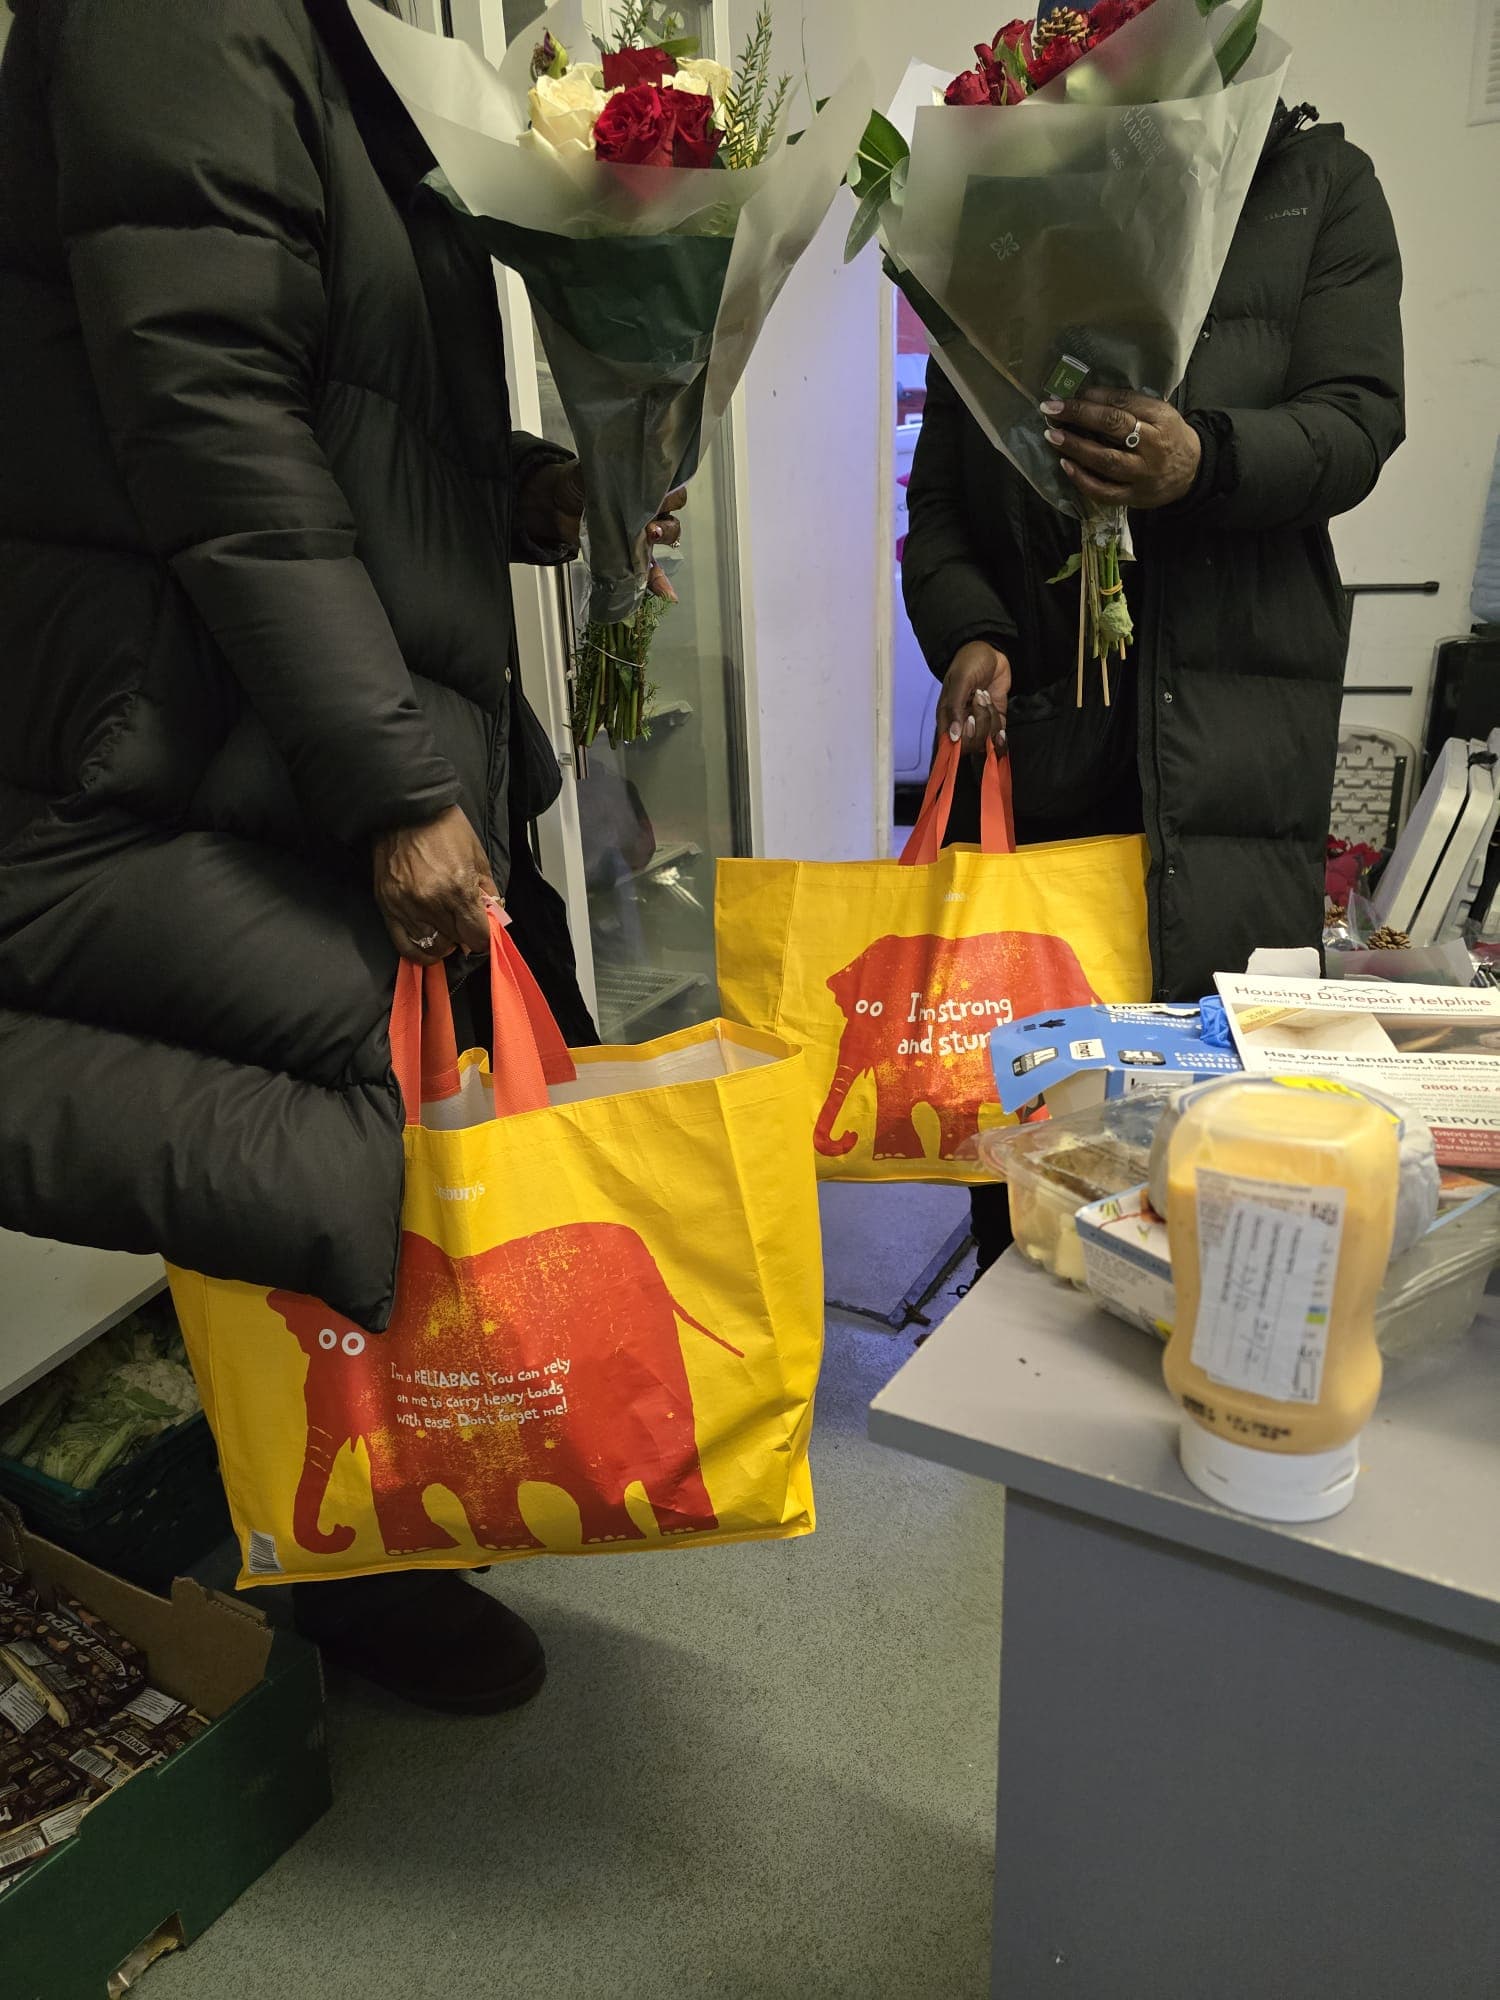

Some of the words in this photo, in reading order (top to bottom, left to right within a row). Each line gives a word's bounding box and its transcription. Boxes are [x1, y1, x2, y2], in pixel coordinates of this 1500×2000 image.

[1111, 1003, 1163, 1011] kmart
[1234, 986, 1312, 1001] Housing
[1318, 990, 1404, 1006] Disrepair
[1410, 996, 1492, 1010] Helpline
[938, 998, 1014, 1024] strong
[897, 1024, 933, 1055] and
[938, 1026, 998, 1056] stur
[1263, 1050, 1296, 1059] Has
[1300, 1053, 1340, 1063] your
[1345, 1054, 1424, 1065] Landlord
[1428, 1057, 1500, 1068] ignored
[1421, 1083, 1459, 1091] 0800
[406, 1374, 412, 1383] a
[487, 1372, 514, 1386] You
[517, 1370, 540, 1382] can
[543, 1357, 571, 1375] rely
[396, 1412, 422, 1428] with
[498, 1408, 540, 1425] forget
[543, 1396, 569, 1416] me!
[397, 1394, 409, 1404] on
[411, 1395, 428, 1406] me
[431, 1396, 443, 1408] to
[446, 1397, 481, 1411] carry
[484, 1391, 525, 1406] heavy
